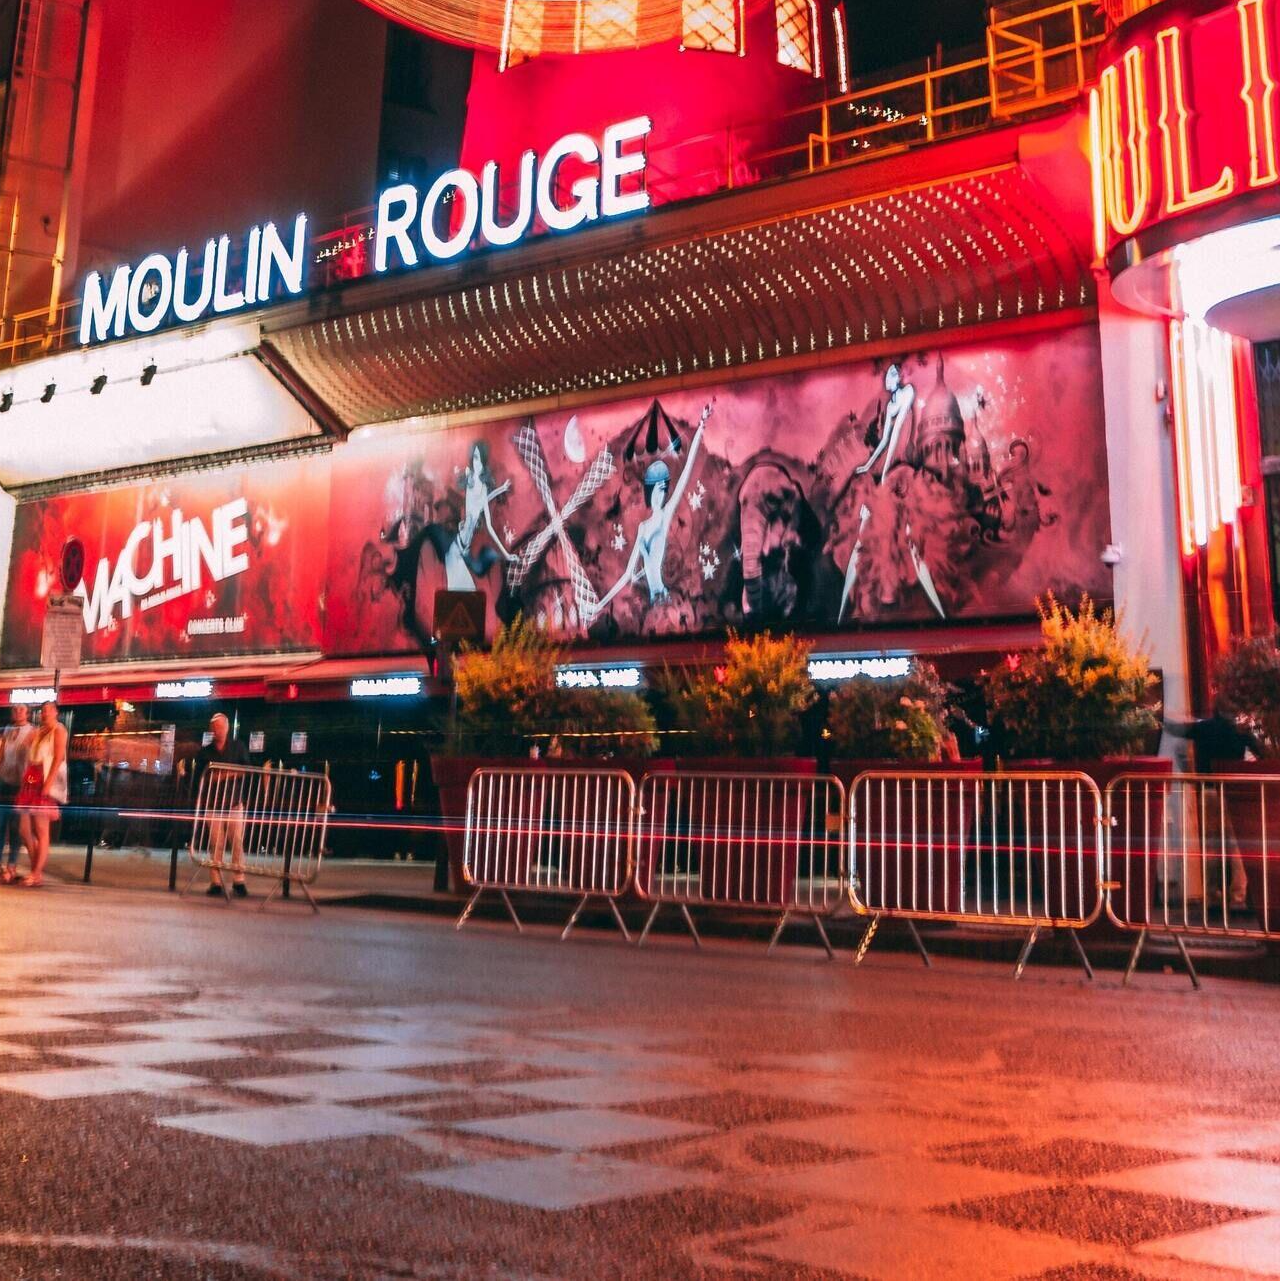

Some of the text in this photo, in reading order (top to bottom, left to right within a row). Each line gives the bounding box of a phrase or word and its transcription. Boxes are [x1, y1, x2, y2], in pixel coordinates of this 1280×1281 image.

[79, 115, 653, 344] MOULIN ROUGE
[73, 496, 250, 634] MACHINE
